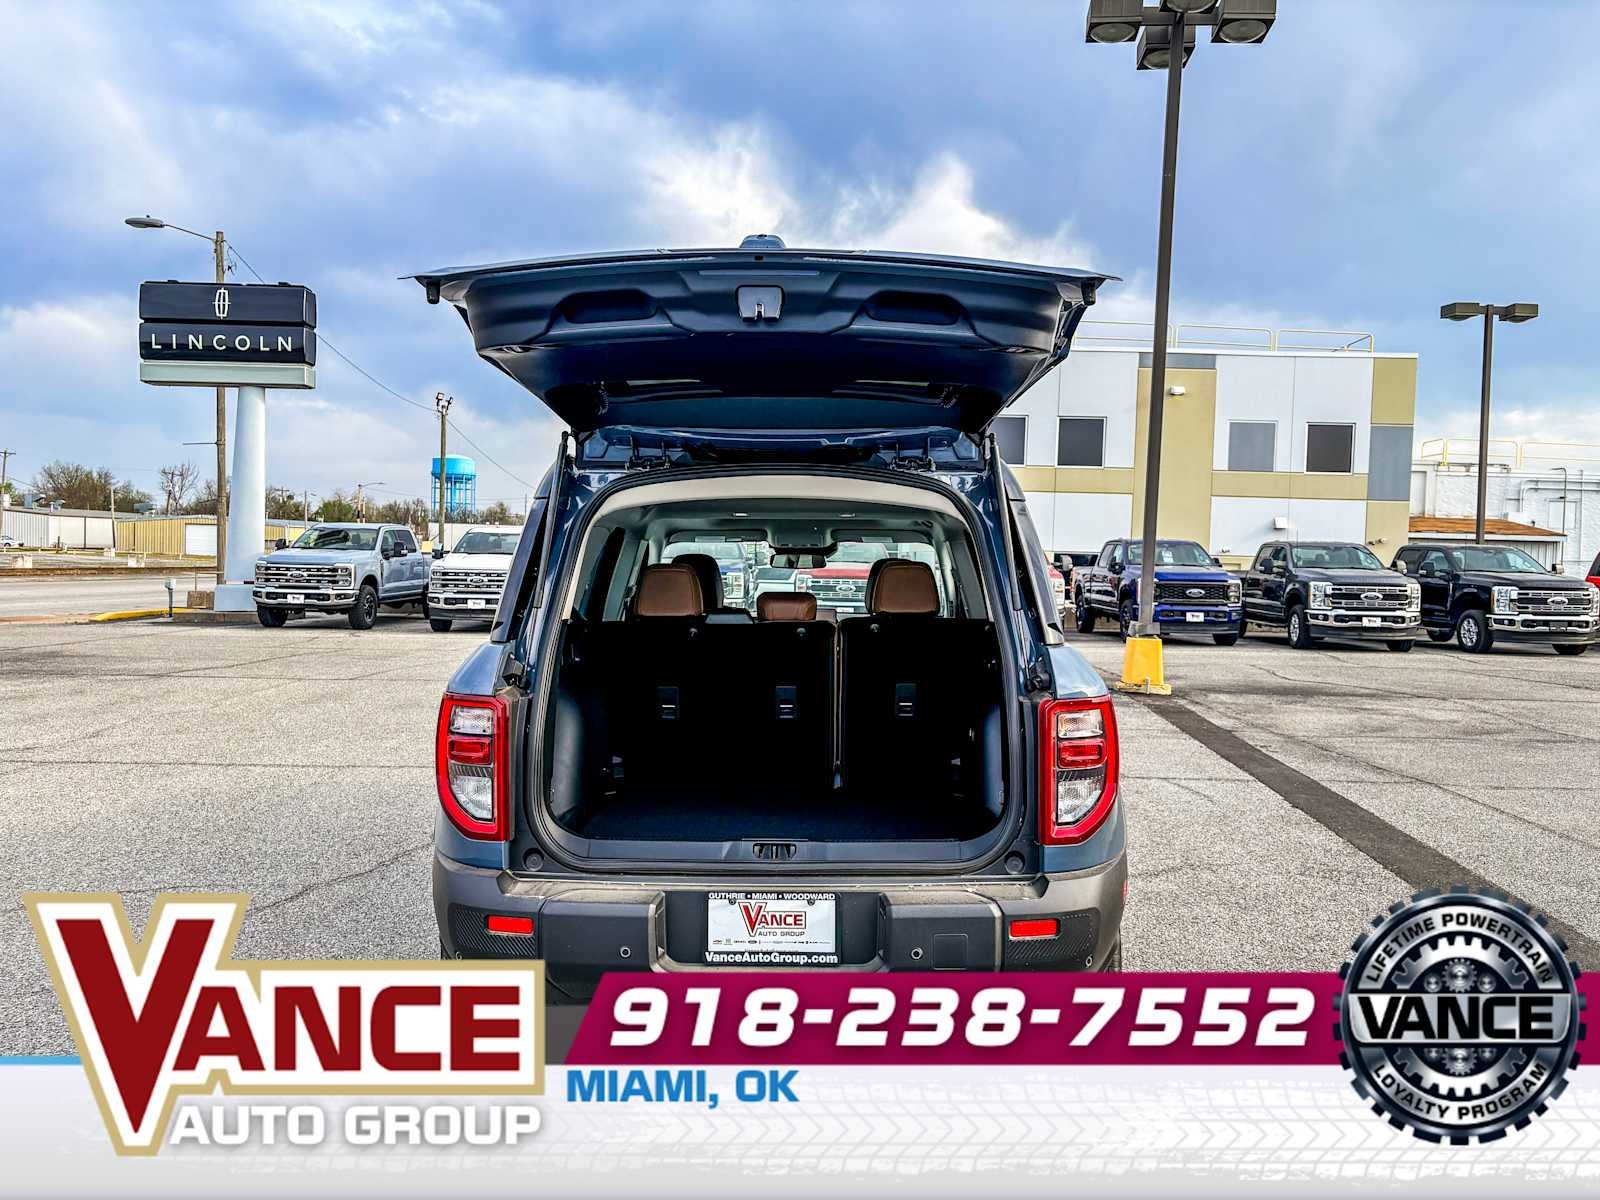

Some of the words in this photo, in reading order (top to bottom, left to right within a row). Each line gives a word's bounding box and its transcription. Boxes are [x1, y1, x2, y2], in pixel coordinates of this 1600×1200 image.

[151, 334, 292, 352] LINCOLN
[740, 904, 805, 936] VANCE
[705, 952, 838, 964] VanceAutoGroup.com
